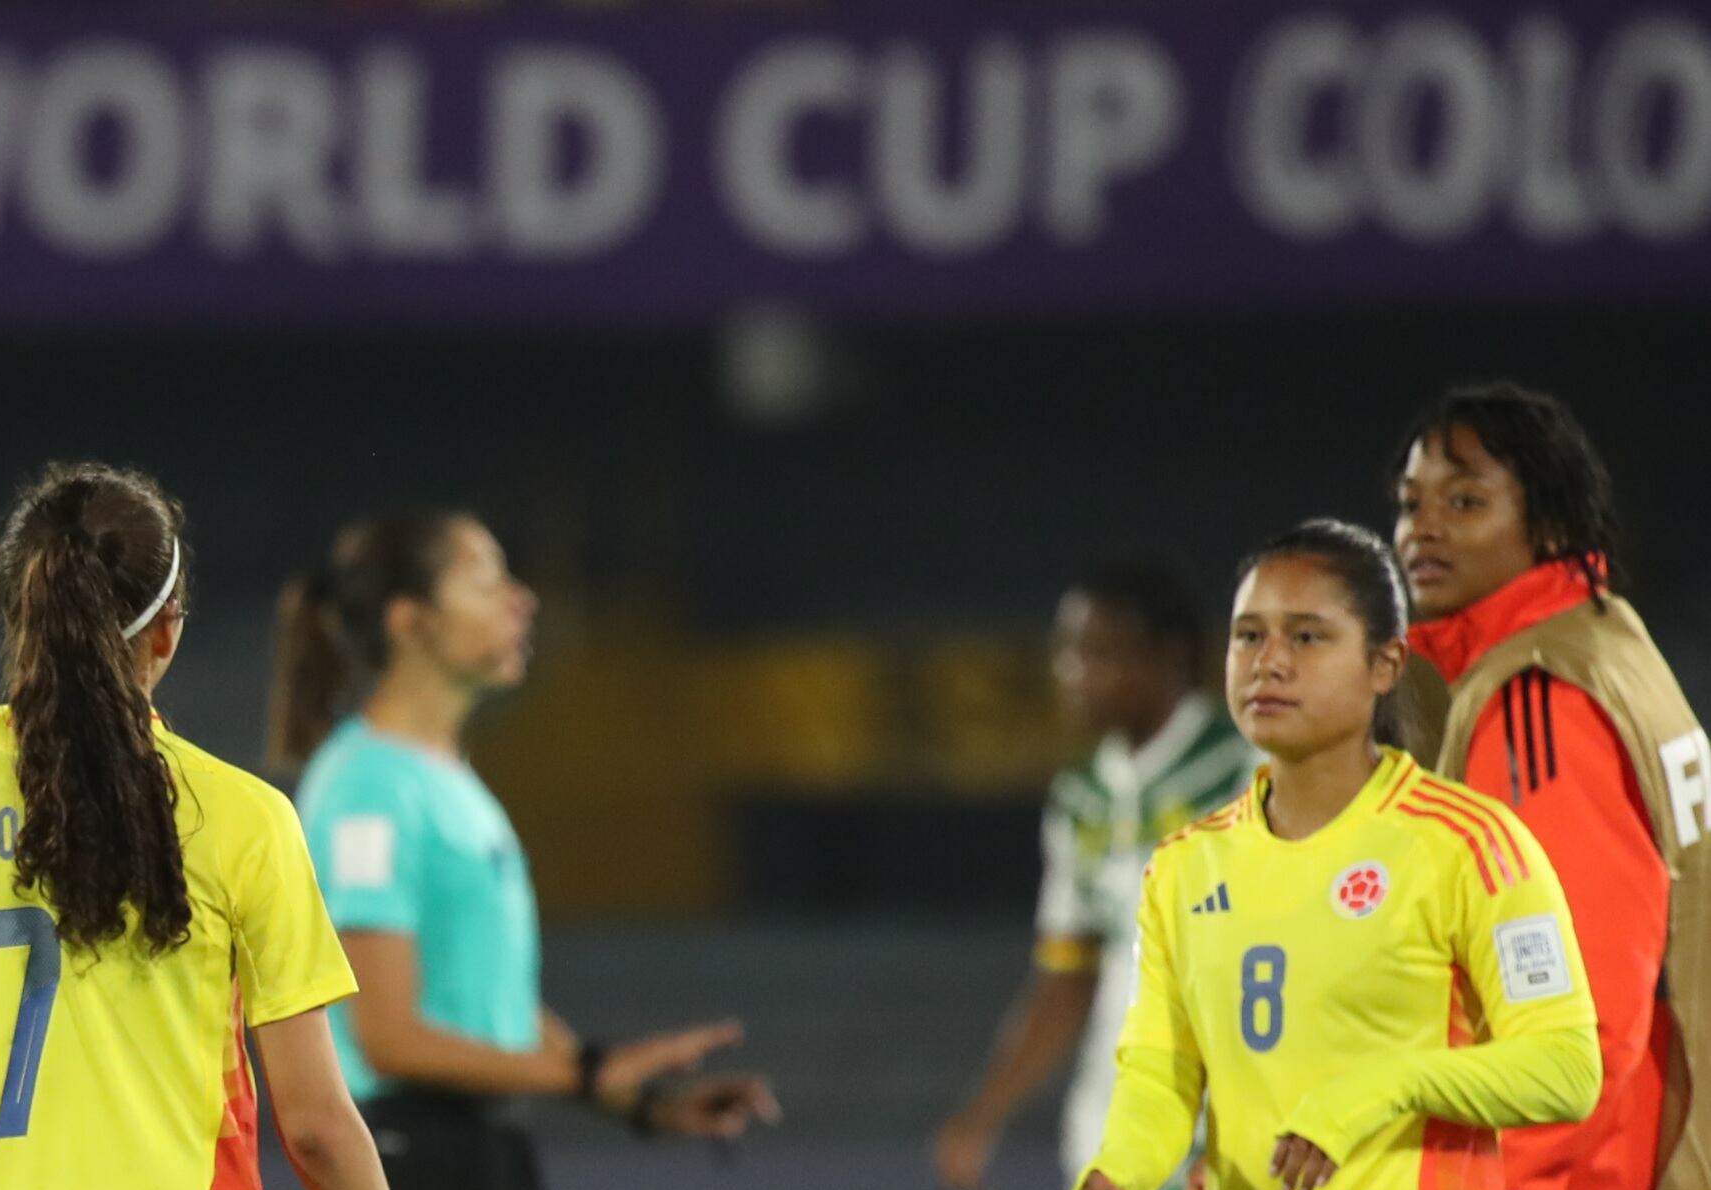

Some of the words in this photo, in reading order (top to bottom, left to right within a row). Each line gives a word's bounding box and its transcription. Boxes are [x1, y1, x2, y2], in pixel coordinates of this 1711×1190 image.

[719, 36, 1185, 256] CUP
[1233, 14, 1711, 240] COLO
[1240, 944, 1287, 1053] 8
